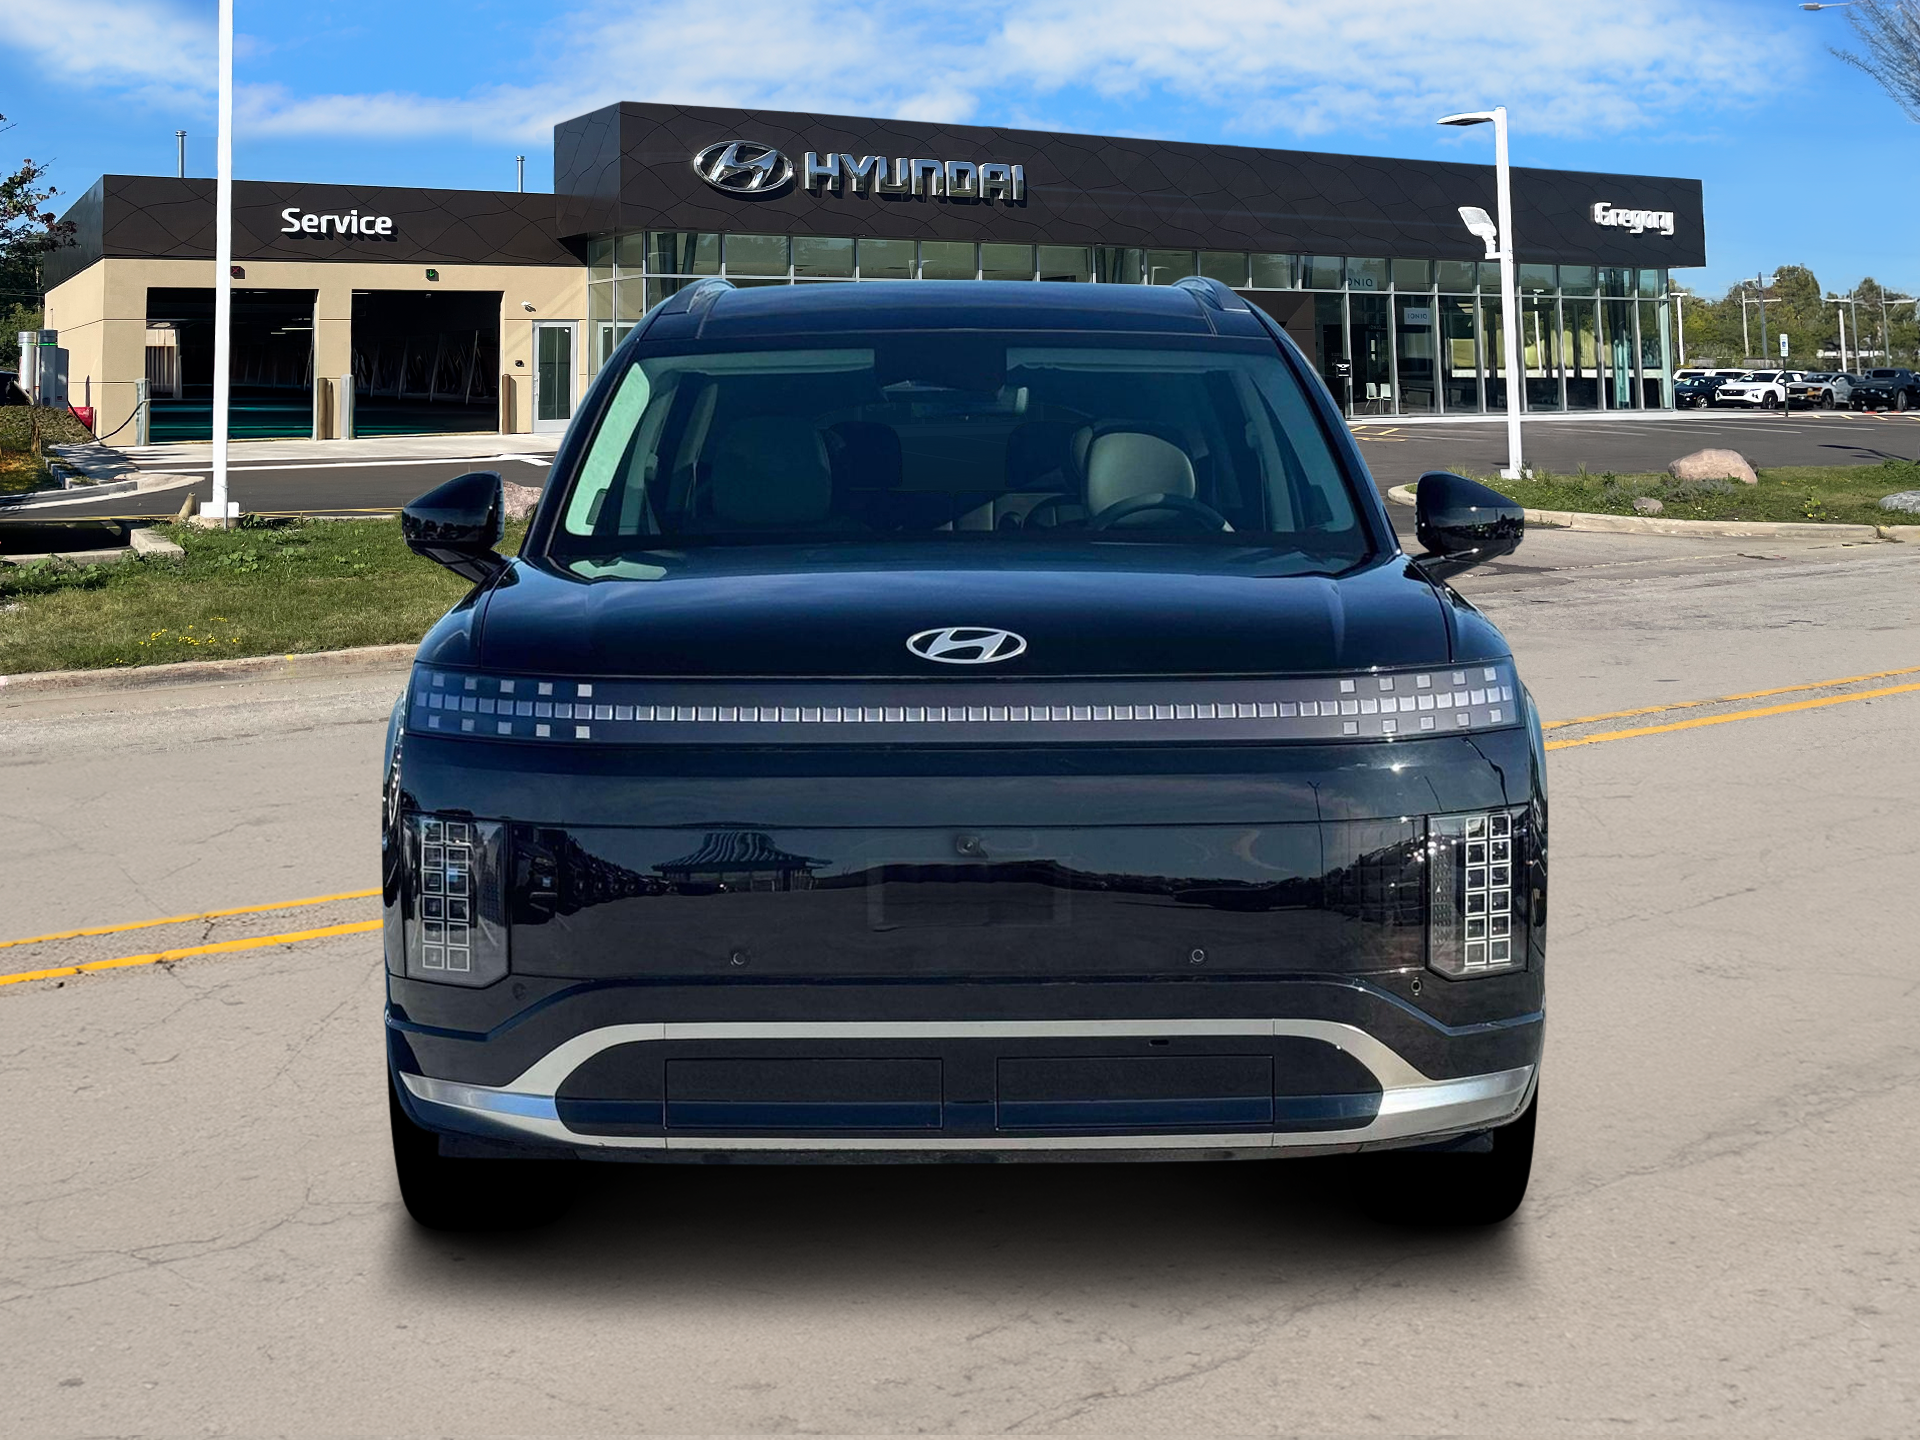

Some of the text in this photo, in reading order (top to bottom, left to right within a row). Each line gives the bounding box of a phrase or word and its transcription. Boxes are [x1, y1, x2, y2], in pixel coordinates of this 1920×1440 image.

[804, 151, 1024, 201] HYUNDAI
[280, 207, 393, 235] Service
[1594, 202, 1675, 235] Gregory
[1347, 278, 1373, 287] ONIQ
